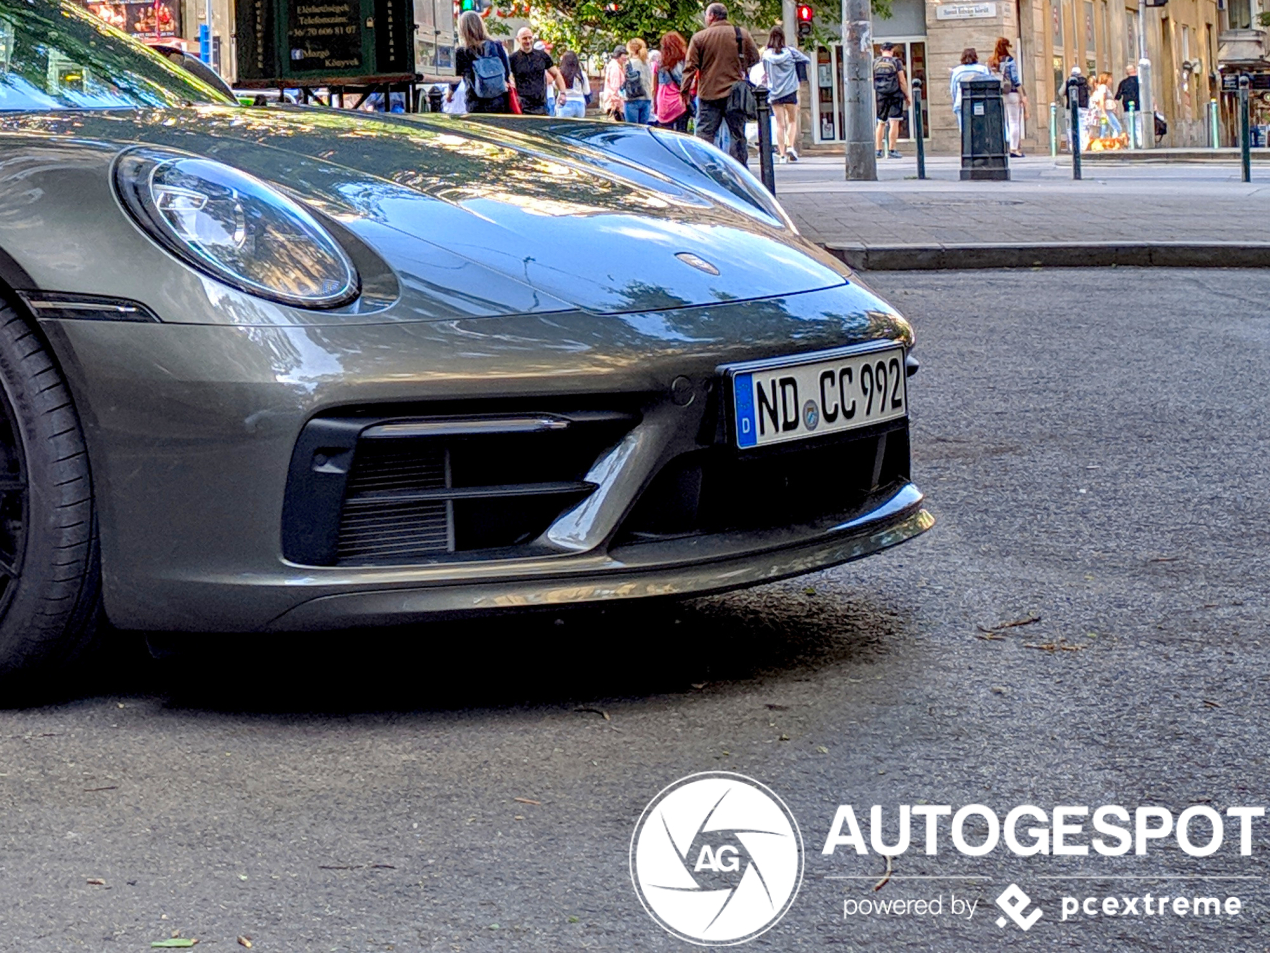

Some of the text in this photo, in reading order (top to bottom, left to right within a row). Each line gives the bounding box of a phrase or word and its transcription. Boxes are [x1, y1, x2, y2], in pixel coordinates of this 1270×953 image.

[742, 357, 903, 436] D ND CC 992
